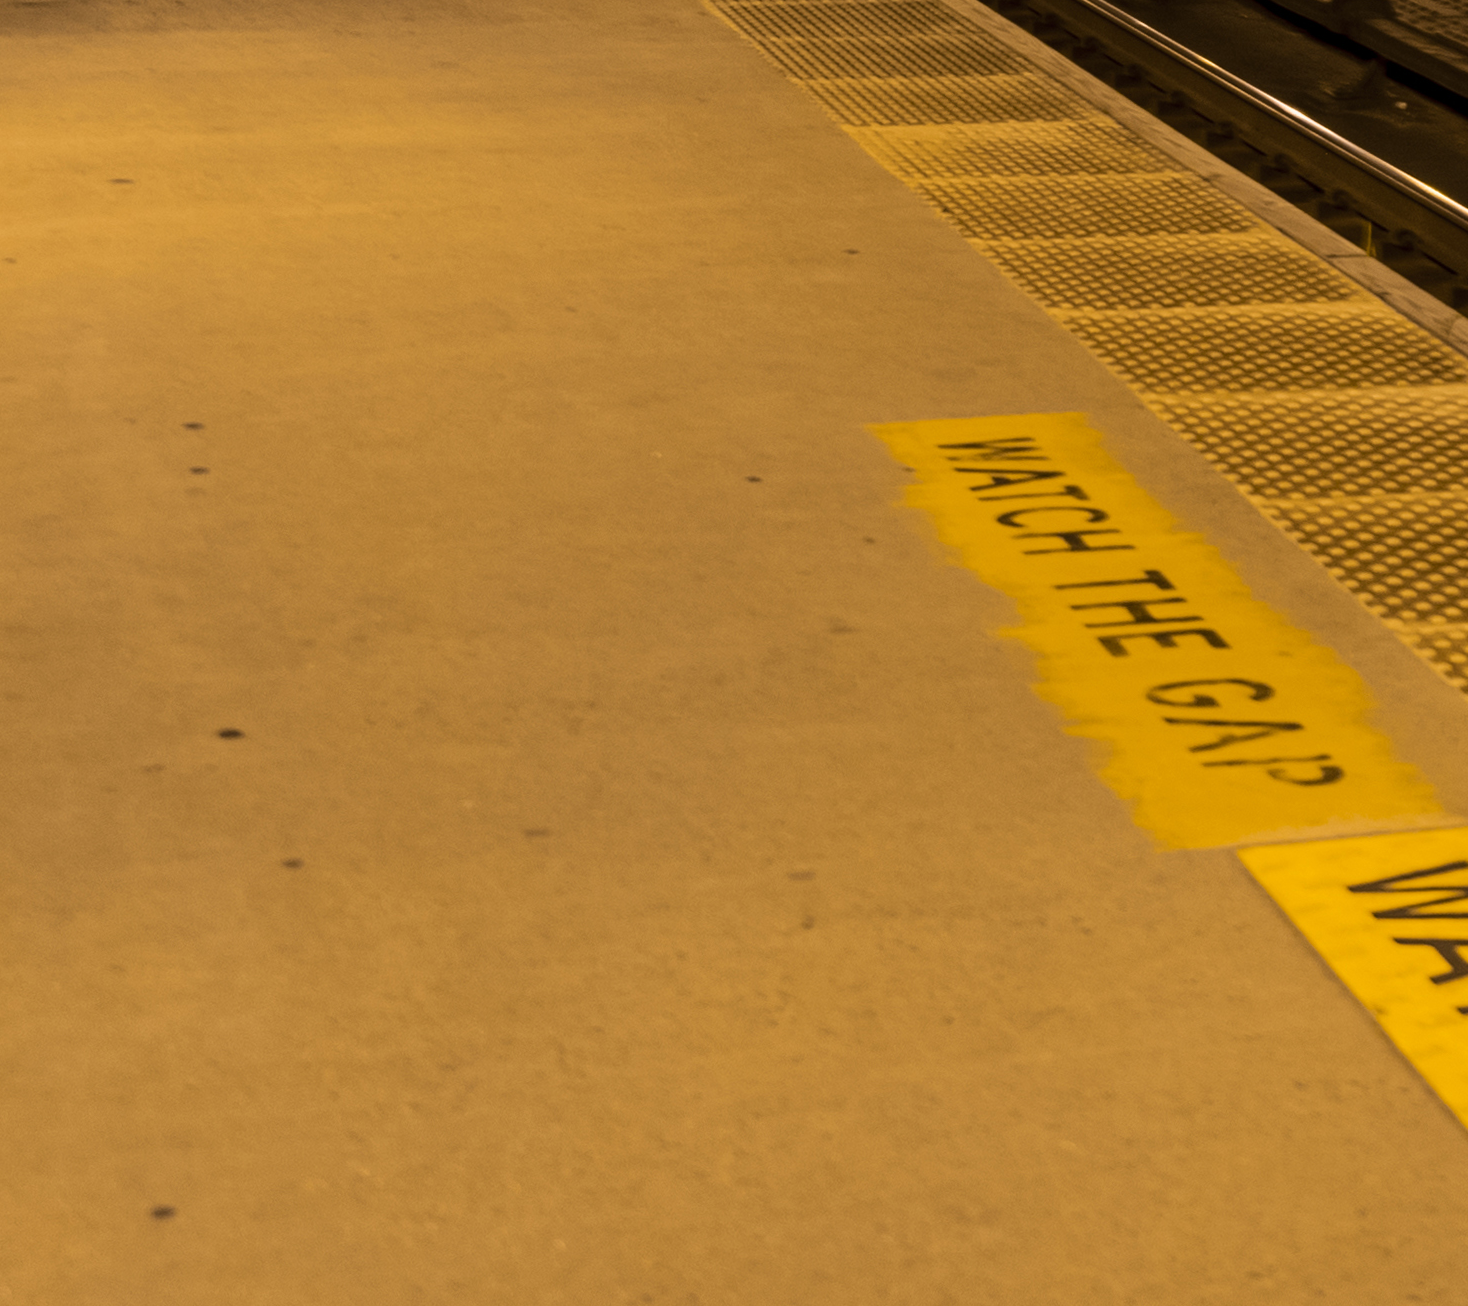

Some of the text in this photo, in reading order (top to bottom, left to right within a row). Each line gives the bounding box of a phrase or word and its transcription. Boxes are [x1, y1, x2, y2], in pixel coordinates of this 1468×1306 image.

[936, 436, 1345, 786] WATCH THE GAP
